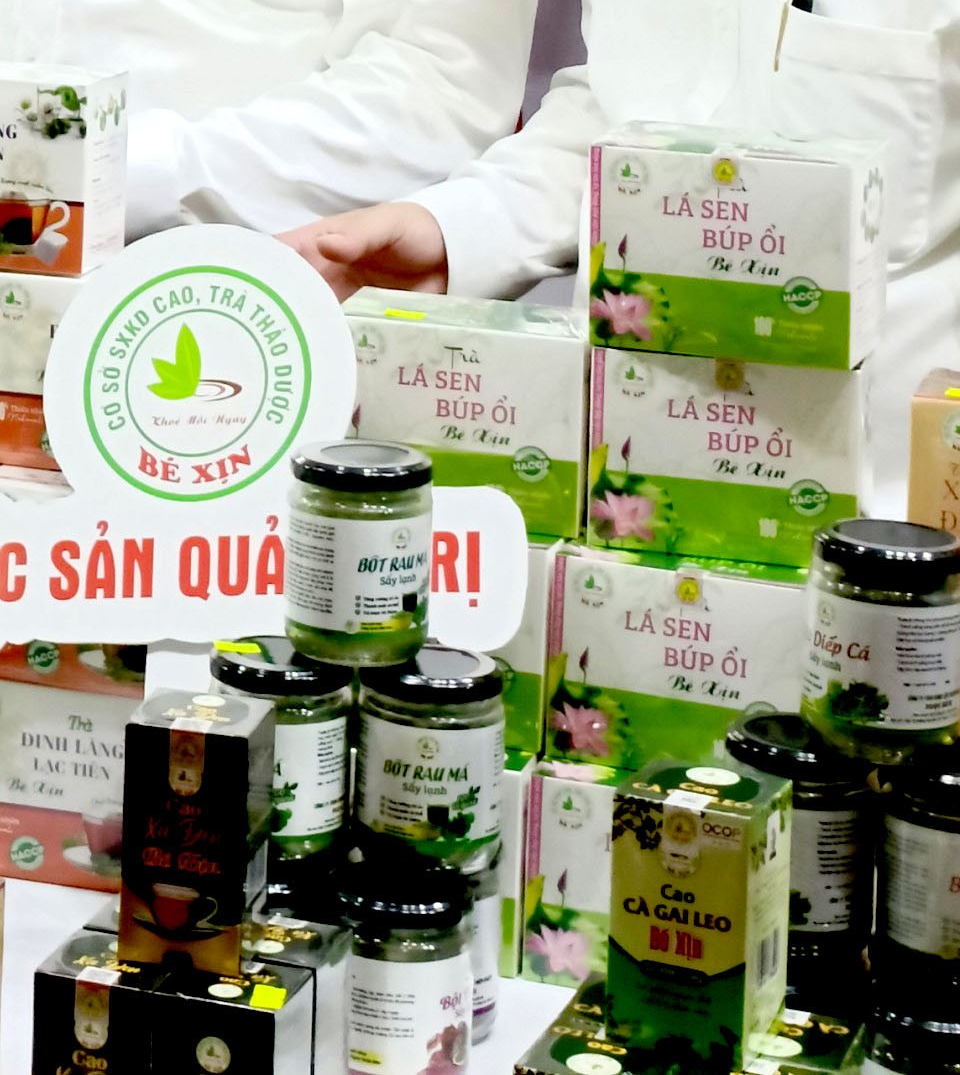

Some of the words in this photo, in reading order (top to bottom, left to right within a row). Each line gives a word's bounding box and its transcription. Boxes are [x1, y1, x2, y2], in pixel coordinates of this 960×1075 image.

[662, 191, 694, 219] LÁ
[700, 199, 749, 223] SEN
[702, 225, 754, 253] BÚP
[758, 223, 787, 256] ỔI
[782, 290, 823, 304] HACCP
[109, 309, 150, 359] SXKD
[151, 285, 201, 315] CAO,
[443, 345, 481, 370] Trà
[397, 362, 429, 388] LÁ
[434, 369, 482, 393] SEN
[435, 395, 485, 422] BÚP
[490, 394, 517, 426] ỔI
[666, 395, 699, 421] LÁ
[706, 401, 757, 426] SEN
[707, 428, 760, 455] BÚP
[765, 426, 794, 459] ỔI
[137, 445, 182, 484] BÉ
[190, 444, 252, 485] XỊN
[789, 492, 829, 506] HACCP
[48, 519, 156, 601] SẢN
[389, 554, 416, 572] RAU
[623, 608, 657, 636] LÁ
[662, 616, 713, 643] SEN
[663, 645, 716, 673] BÚP
[720, 645, 748, 679] ỔI
[813, 629, 843, 658] Diếp
[845, 639, 871, 665] Cá
[413, 763, 445, 782] RAU
[446, 761, 470, 783] MÁ
[660, 883, 696, 905] Cao
[622, 895, 650, 918] CÀ
[653, 903, 690, 925] GAI
[693, 911, 733, 934] LEO
